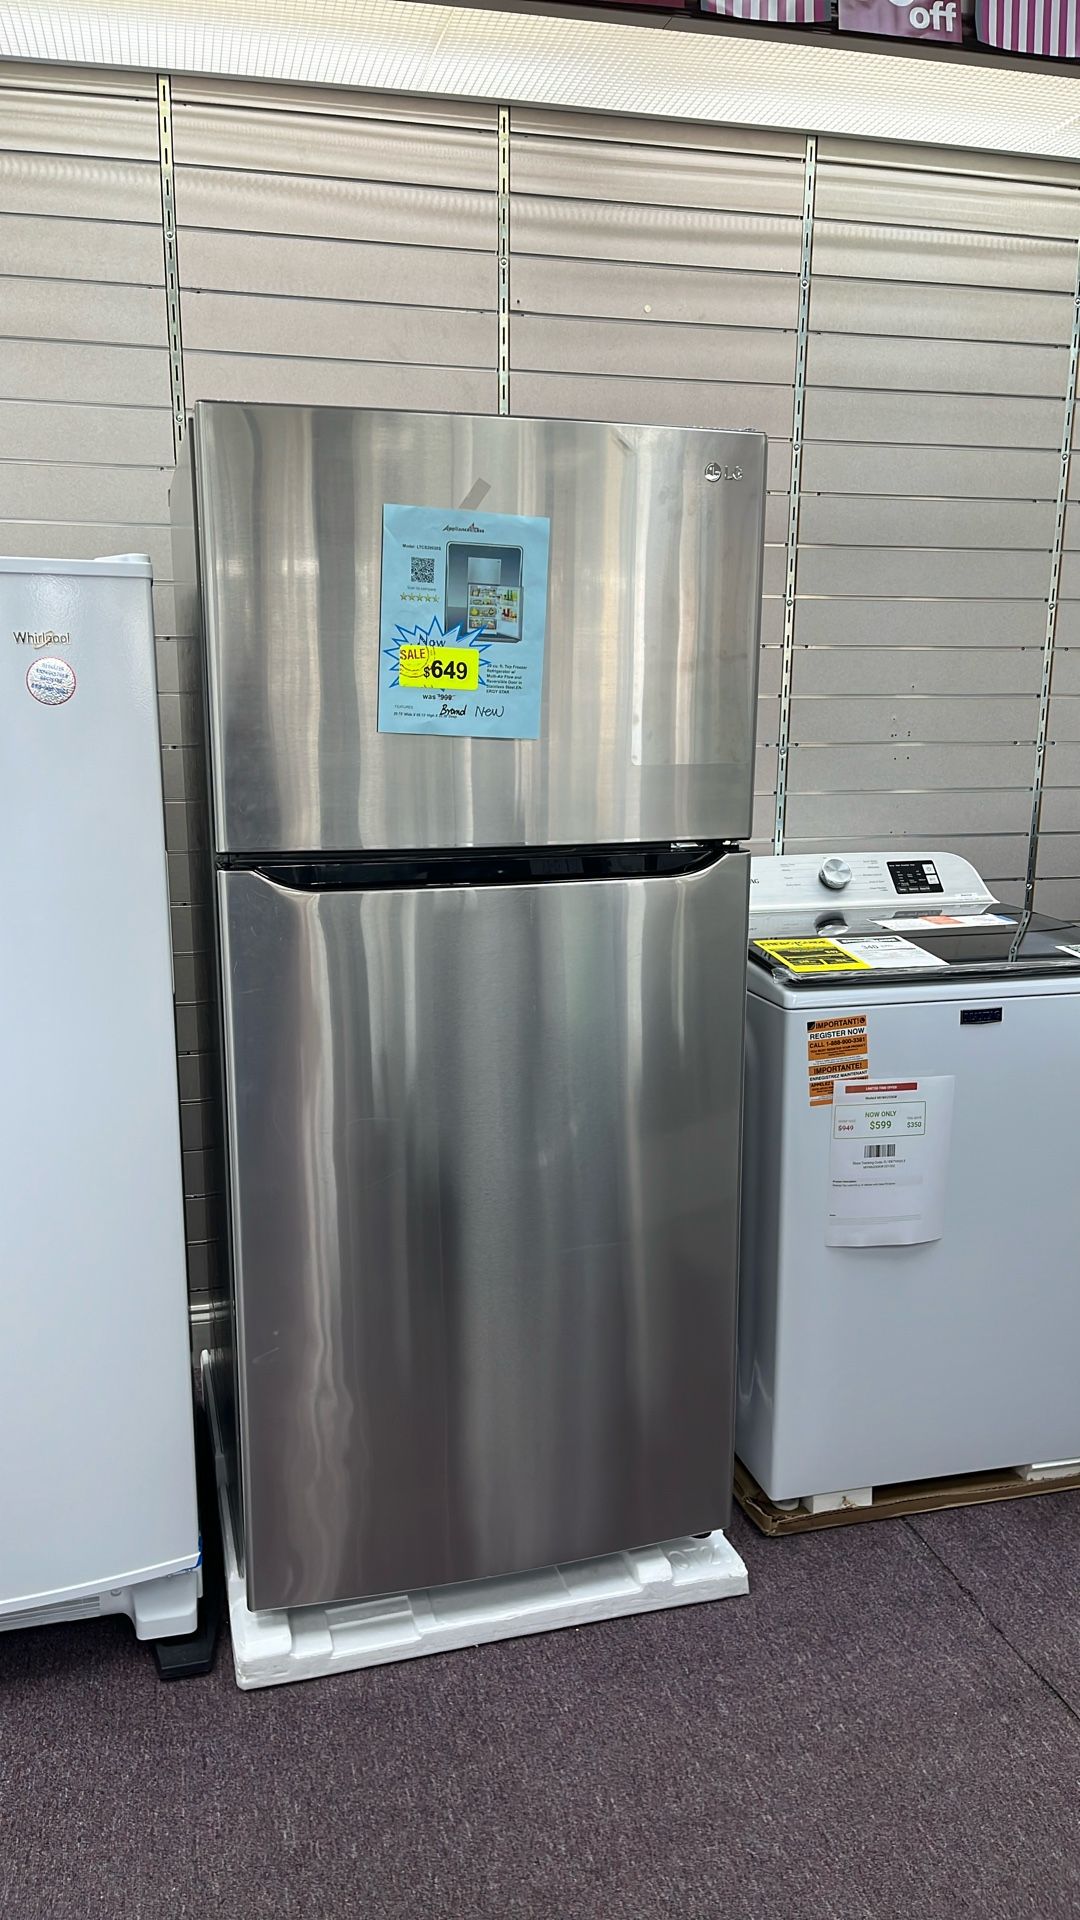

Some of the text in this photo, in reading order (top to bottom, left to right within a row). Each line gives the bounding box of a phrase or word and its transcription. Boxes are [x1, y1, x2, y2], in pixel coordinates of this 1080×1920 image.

[909, 1, 957, 32] off
[13, 631, 70, 646] Whirlpool
[417, 633, 446, 647] Now
[400, 648, 426, 660] SALE
[423, 660, 468, 680] $649
[440, 703, 505, 718] Brand New
[815, 1017, 860, 1030] IMPORTANT!
[809, 1027, 865, 1040] REGISTER NOW
[809, 1040, 825, 1049] CALL
[869, 1120, 892, 1131] $599
[907, 1121, 922, 1129] $350
